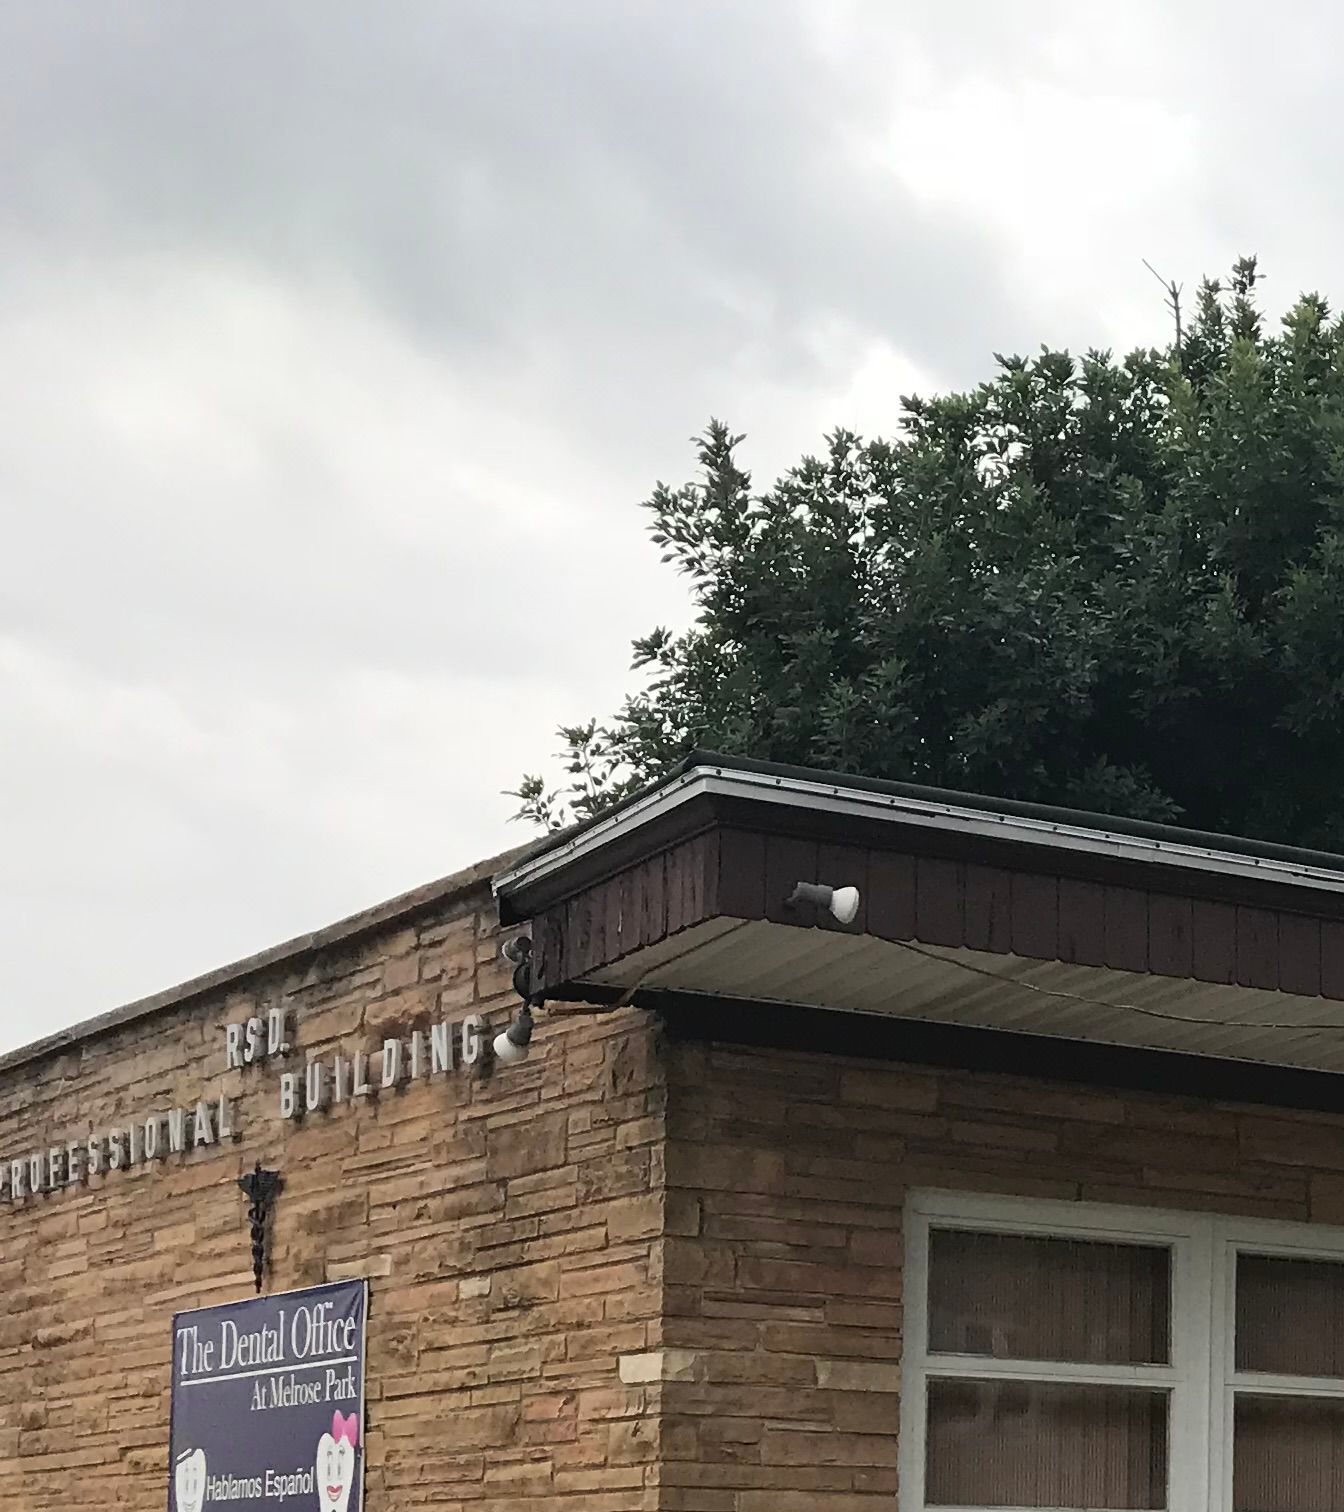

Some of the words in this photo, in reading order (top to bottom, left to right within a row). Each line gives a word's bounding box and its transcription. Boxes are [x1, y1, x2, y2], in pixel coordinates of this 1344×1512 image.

[0, 1094, 232, 1199] ROFESSIONAL
[280, 1014, 483, 1119] BUILDING
[176, 1325, 214, 1375] The
[219, 1310, 285, 1370] Dental
[291, 1302, 357, 1359] Office
[250, 1380, 267, 1411] At
[270, 1373, 322, 1409] Melrose
[325, 1366, 357, 1401] Park
[206, 1474, 262, 1501] Hablamos
[265, 1466, 315, 1502] Español
